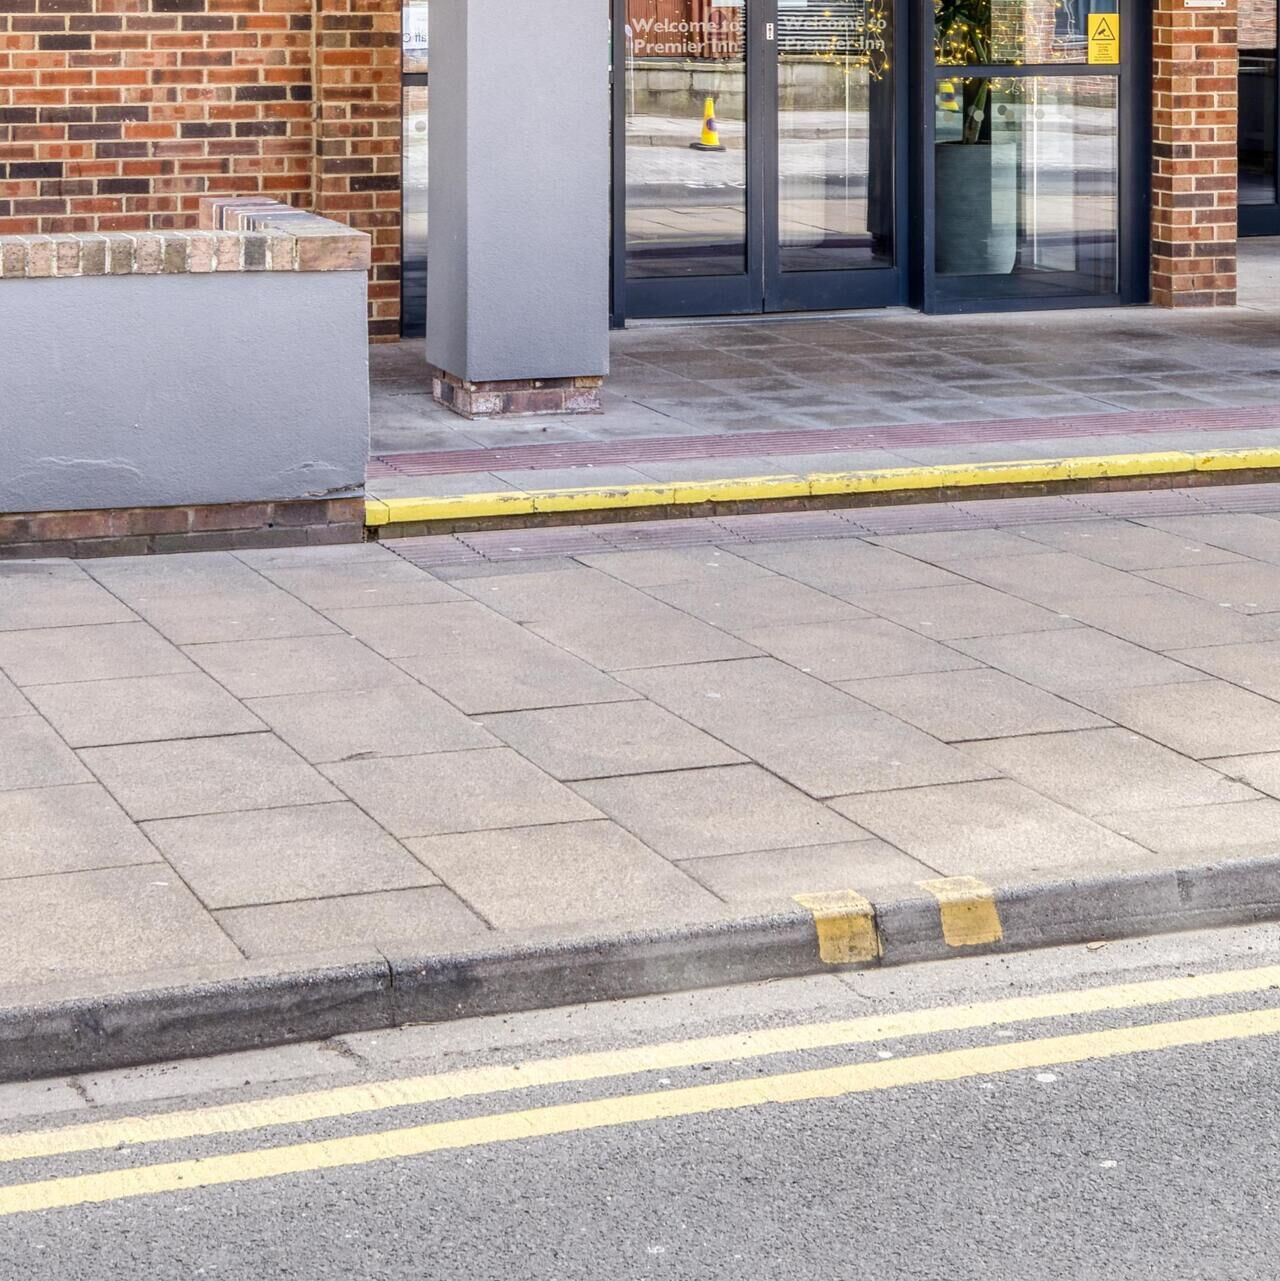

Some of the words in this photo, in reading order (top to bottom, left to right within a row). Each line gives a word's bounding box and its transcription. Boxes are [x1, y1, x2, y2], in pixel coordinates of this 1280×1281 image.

[631, 18, 714, 33] Welcome
[721, 19, 740, 33] to
[869, 17, 887, 30] to
[634, 39, 706, 54] Premier
[711, 39, 738, 53] Inn
[859, 35, 886, 50] Inn
